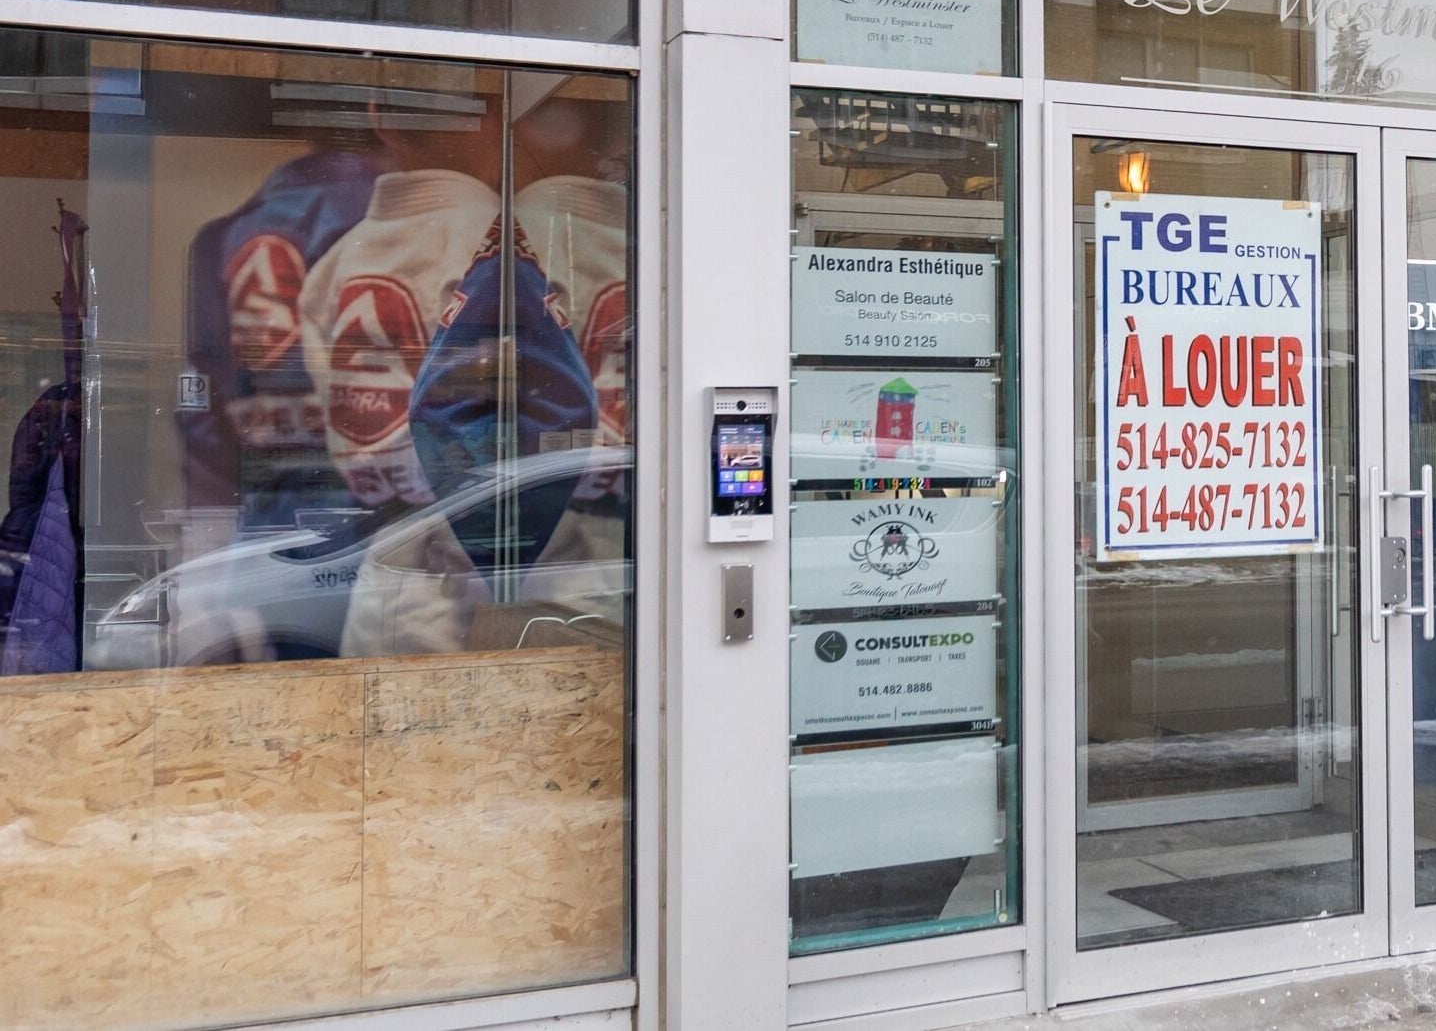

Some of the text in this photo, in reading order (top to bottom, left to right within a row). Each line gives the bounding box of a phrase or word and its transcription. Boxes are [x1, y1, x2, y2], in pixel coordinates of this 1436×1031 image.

[845, 13, 880, 24] Bureaux
[891, 16, 920, 29] Espace
[929, 19, 953, 30] Louer
[890, 33, 905, 43] 487
[1120, 211, 1301, 260] TGE GESTION
[808, 254, 984, 278] Alexandra Esthétique
[1120, 269, 1302, 308] BUREAUX
[835, 290, 953, 306] Salon de Beauté
[858, 309, 931, 322] Beauty Salon
[845, 335, 937, 348] 514 910 2125
[974, 358, 990, 368] 205
[1116, 316, 1306, 408] À LOUER
[1116, 421, 1307, 470] 514-825-7132
[854, 477, 931, 491] 514-419-2324
[851, 503, 938, 526] WAMY INK
[1117, 482, 1307, 534] 514-487-7132
[843, 578, 948, 603] Boutique Tatouage
[977, 601, 993, 611] 204
[855, 632, 974, 651] CONSULTEXPO
[897, 655, 932, 665] TRANSPORT
